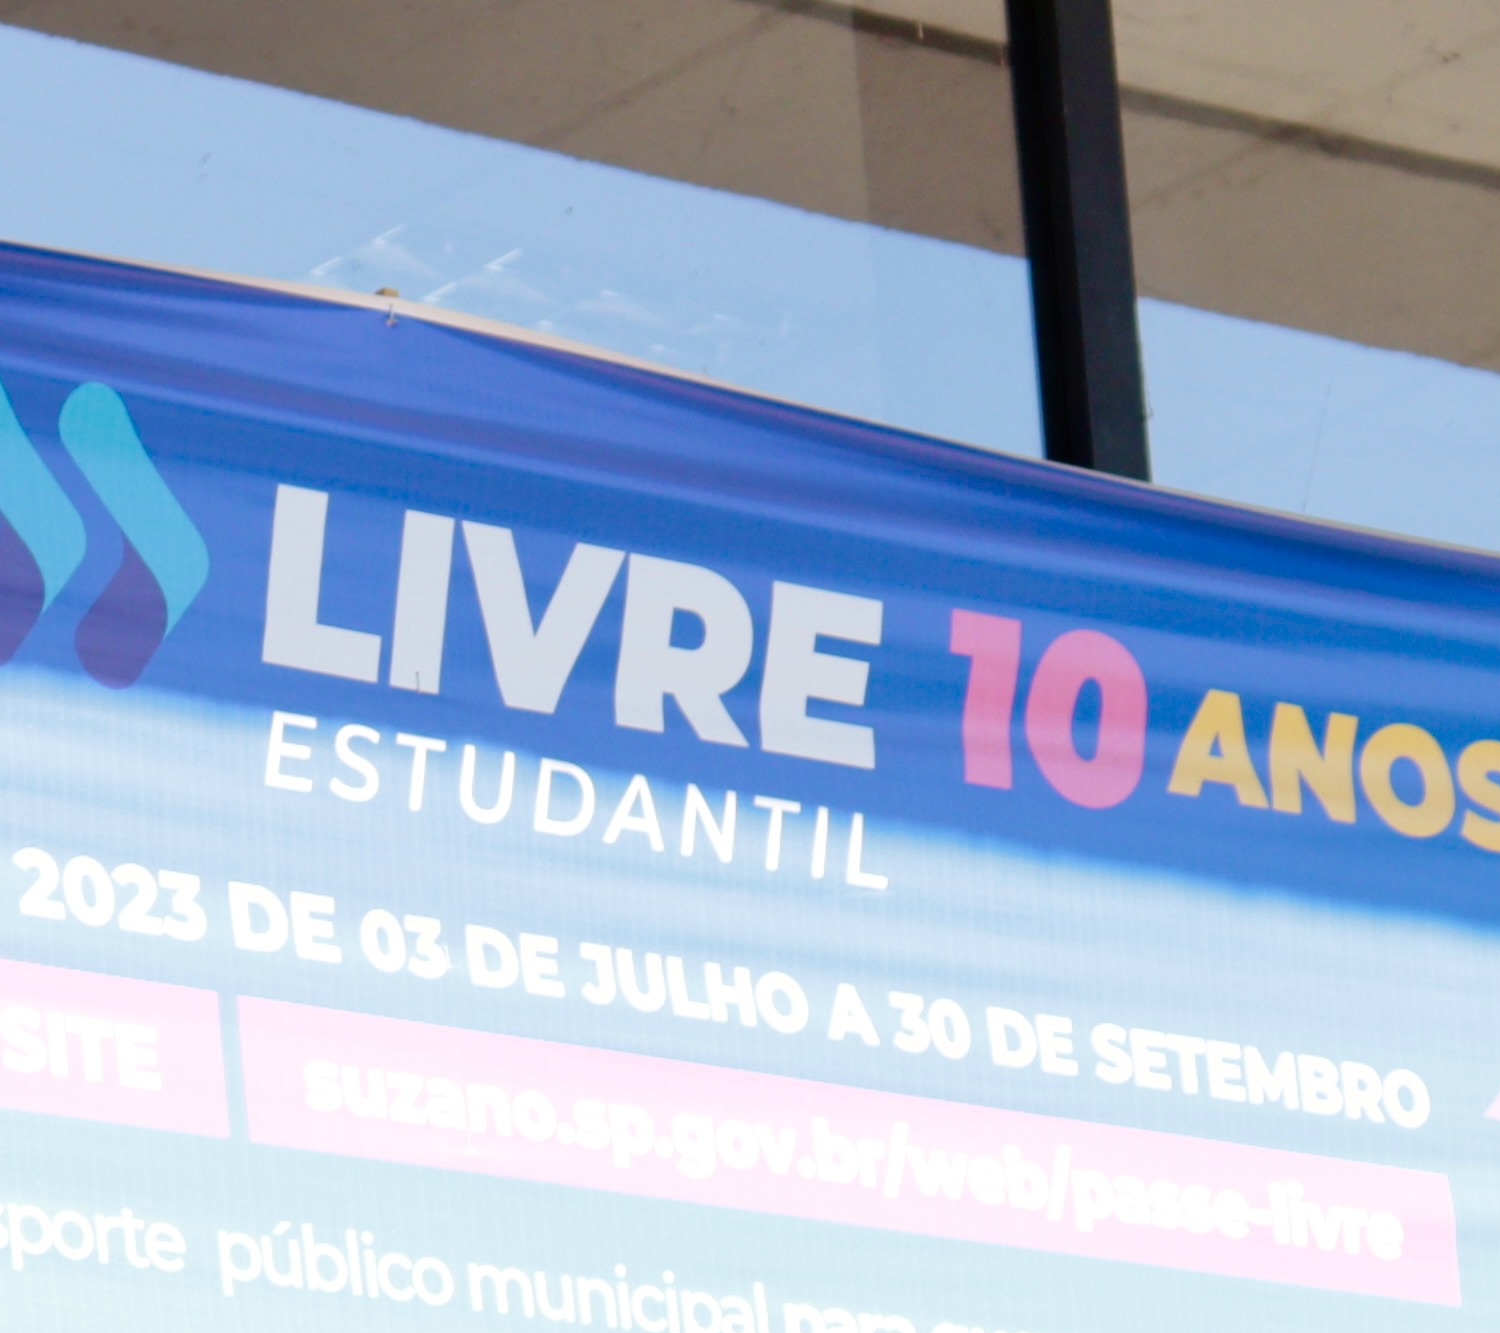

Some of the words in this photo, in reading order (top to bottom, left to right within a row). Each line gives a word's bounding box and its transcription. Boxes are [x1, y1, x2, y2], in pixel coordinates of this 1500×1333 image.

[262, 483, 883, 770] LIVRE
[949, 608, 1149, 809] 10
[264, 709, 888, 891] ESTUDANTIL
[1, 1003, 163, 1092] SITE
[12, 846, 208, 943] 2023
[228, 880, 343, 965] DE
[359, 908, 448, 981] 03
[464, 923, 566, 1000] DE
[578, 941, 810, 1035] JULHO
[827, 982, 881, 1047] A
[888, 991, 971, 1061] 30
[984, 1004, 1079, 1077] DE
[1091, 1022, 1431, 1130] SETEMBRO
[303, 1059, 1404, 1262] suzano.sp.gov.br/web/passe-livre
[218, 1220, 454, 1306] público
